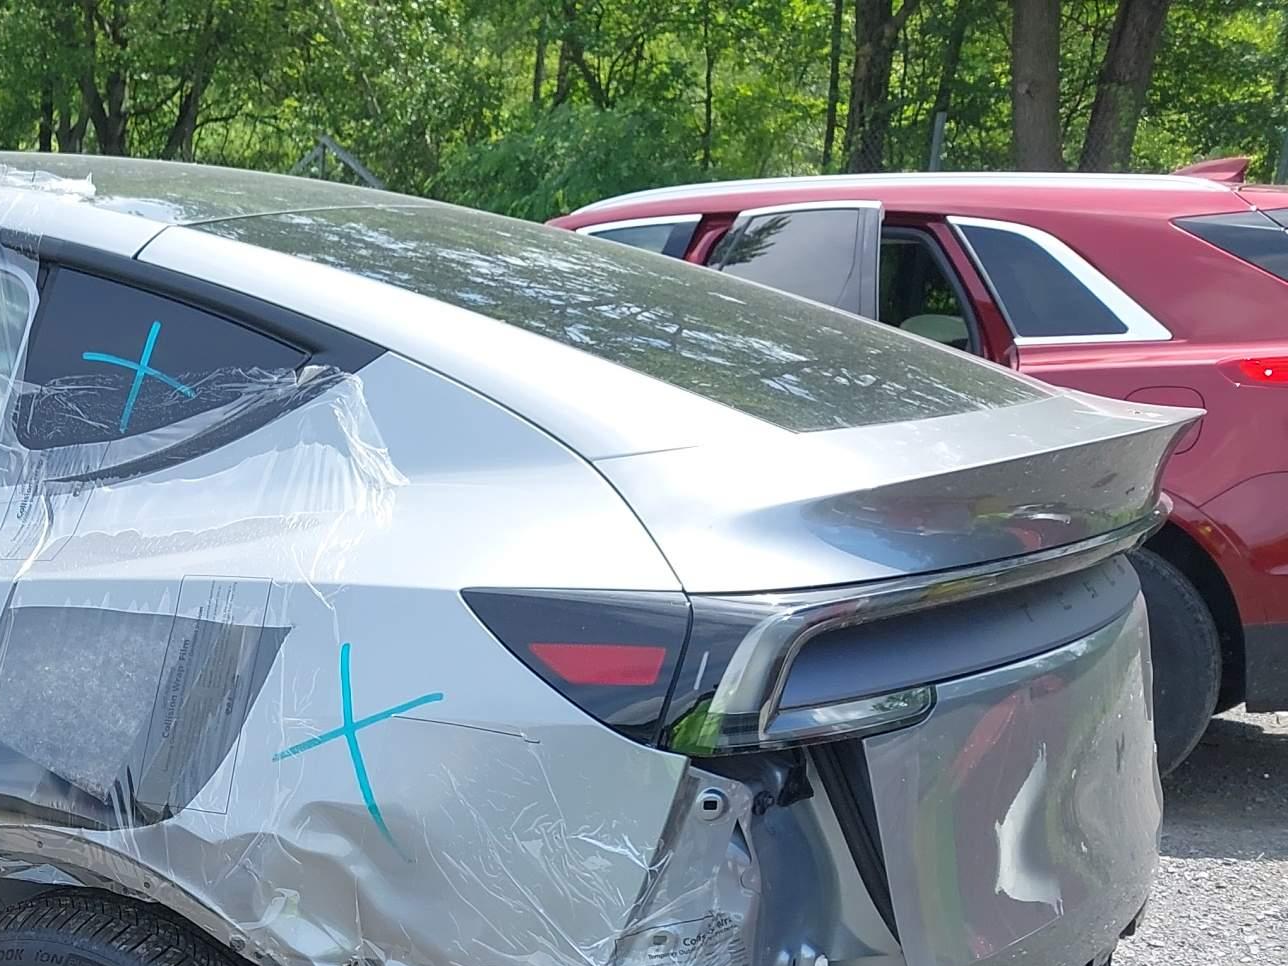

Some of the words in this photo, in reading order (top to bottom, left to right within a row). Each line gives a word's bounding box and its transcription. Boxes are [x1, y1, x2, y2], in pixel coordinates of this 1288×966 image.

[178, 639, 191, 660] Film
[171, 661, 186, 695] Wrap
[162, 696, 178, 739] Collision
